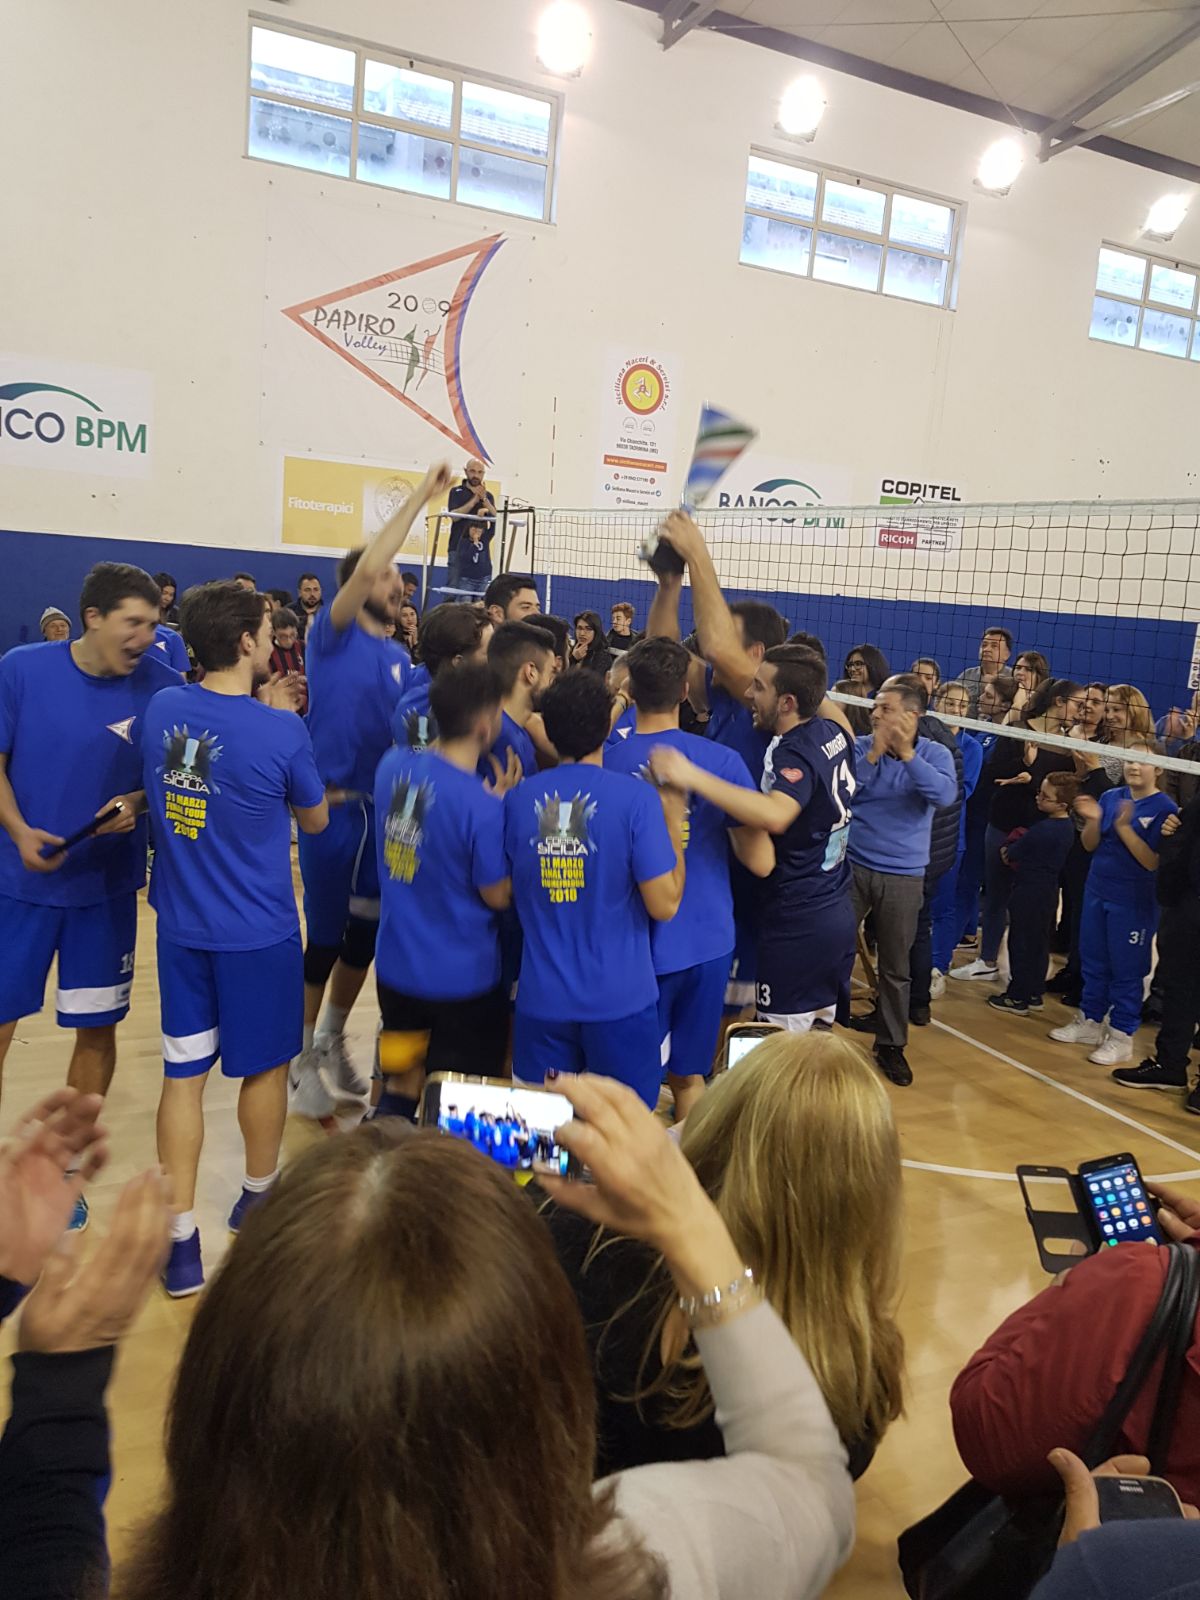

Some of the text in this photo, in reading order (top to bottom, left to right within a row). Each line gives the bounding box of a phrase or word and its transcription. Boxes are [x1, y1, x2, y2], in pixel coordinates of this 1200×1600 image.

[313, 306, 395, 335] PAPIRO
[344, 332, 387, 356] Volley
[76, 416, 147, 453] BPM
[881, 479, 961, 502] COPITEL
[288, 496, 354, 516] Fitoterapici
[881, 533, 915, 545] RICOH
[163, 773, 211, 795] SICILIA
[170, 769, 203, 783] COPPA
[176, 794, 207, 809] MARZO
[184, 807, 206, 820] FOUR
[537, 842, 588, 856] SICILIA
[552, 856, 584, 869] MARZO
